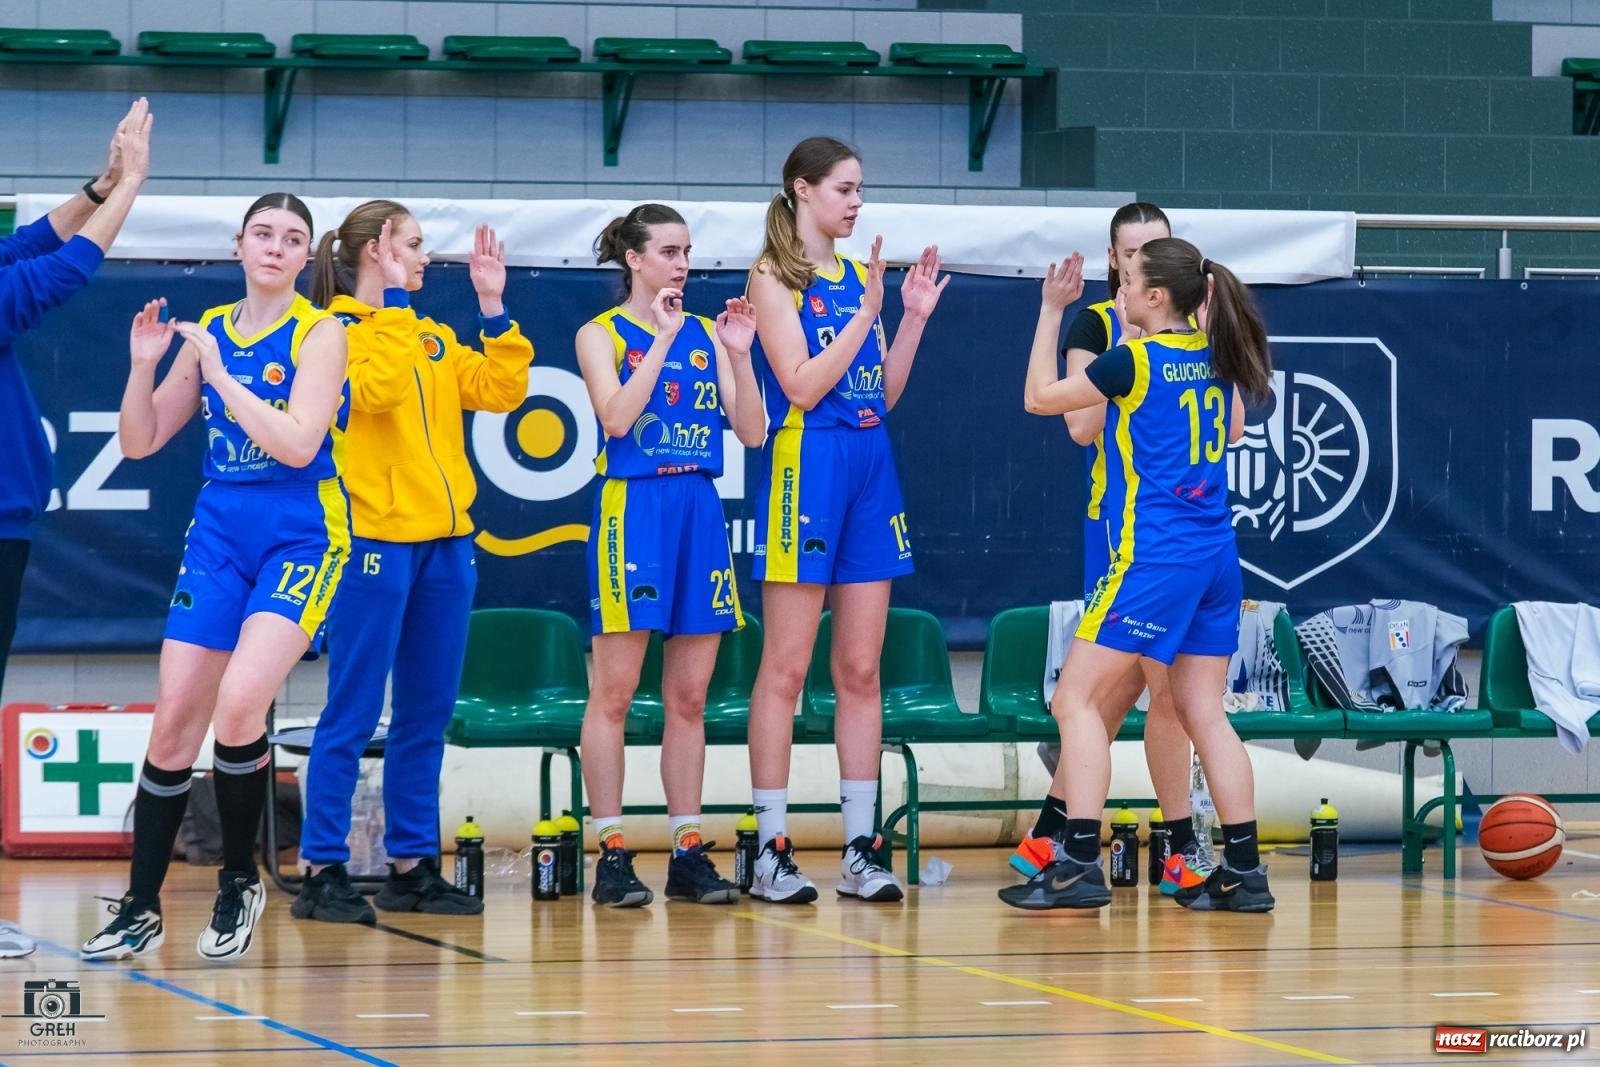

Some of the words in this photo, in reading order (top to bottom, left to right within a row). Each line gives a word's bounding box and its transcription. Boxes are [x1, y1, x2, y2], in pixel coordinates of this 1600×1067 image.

[694, 381, 718, 410] 23
[1179, 385, 1226, 465] 13
[781, 467, 794, 554] CHROBRY
[363, 553, 382, 575] 15
[607, 516, 621, 603] CHROBRY
[277, 561, 316, 601] 12
[710, 568, 734, 608] 23
